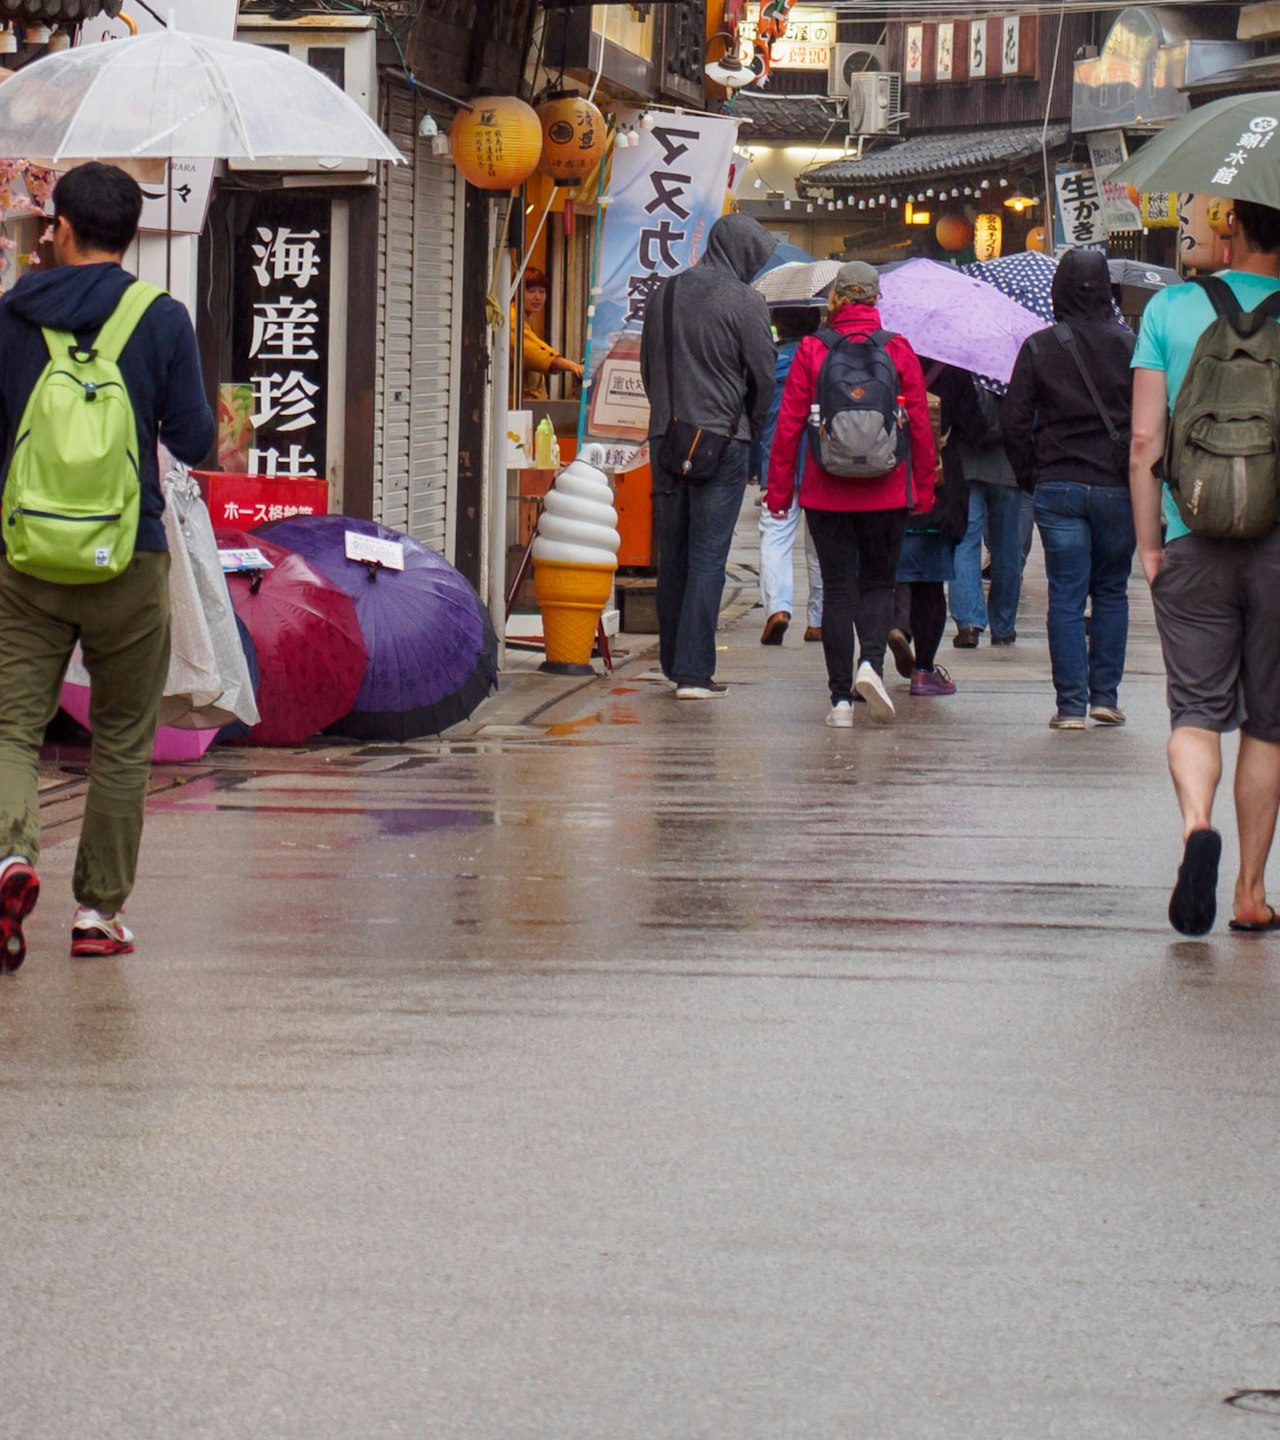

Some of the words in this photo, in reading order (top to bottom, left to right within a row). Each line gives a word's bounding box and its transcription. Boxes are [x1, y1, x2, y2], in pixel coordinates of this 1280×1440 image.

[1061, 174, 1102, 242] 生かき
[248, 226, 322, 480] 海産珍味
